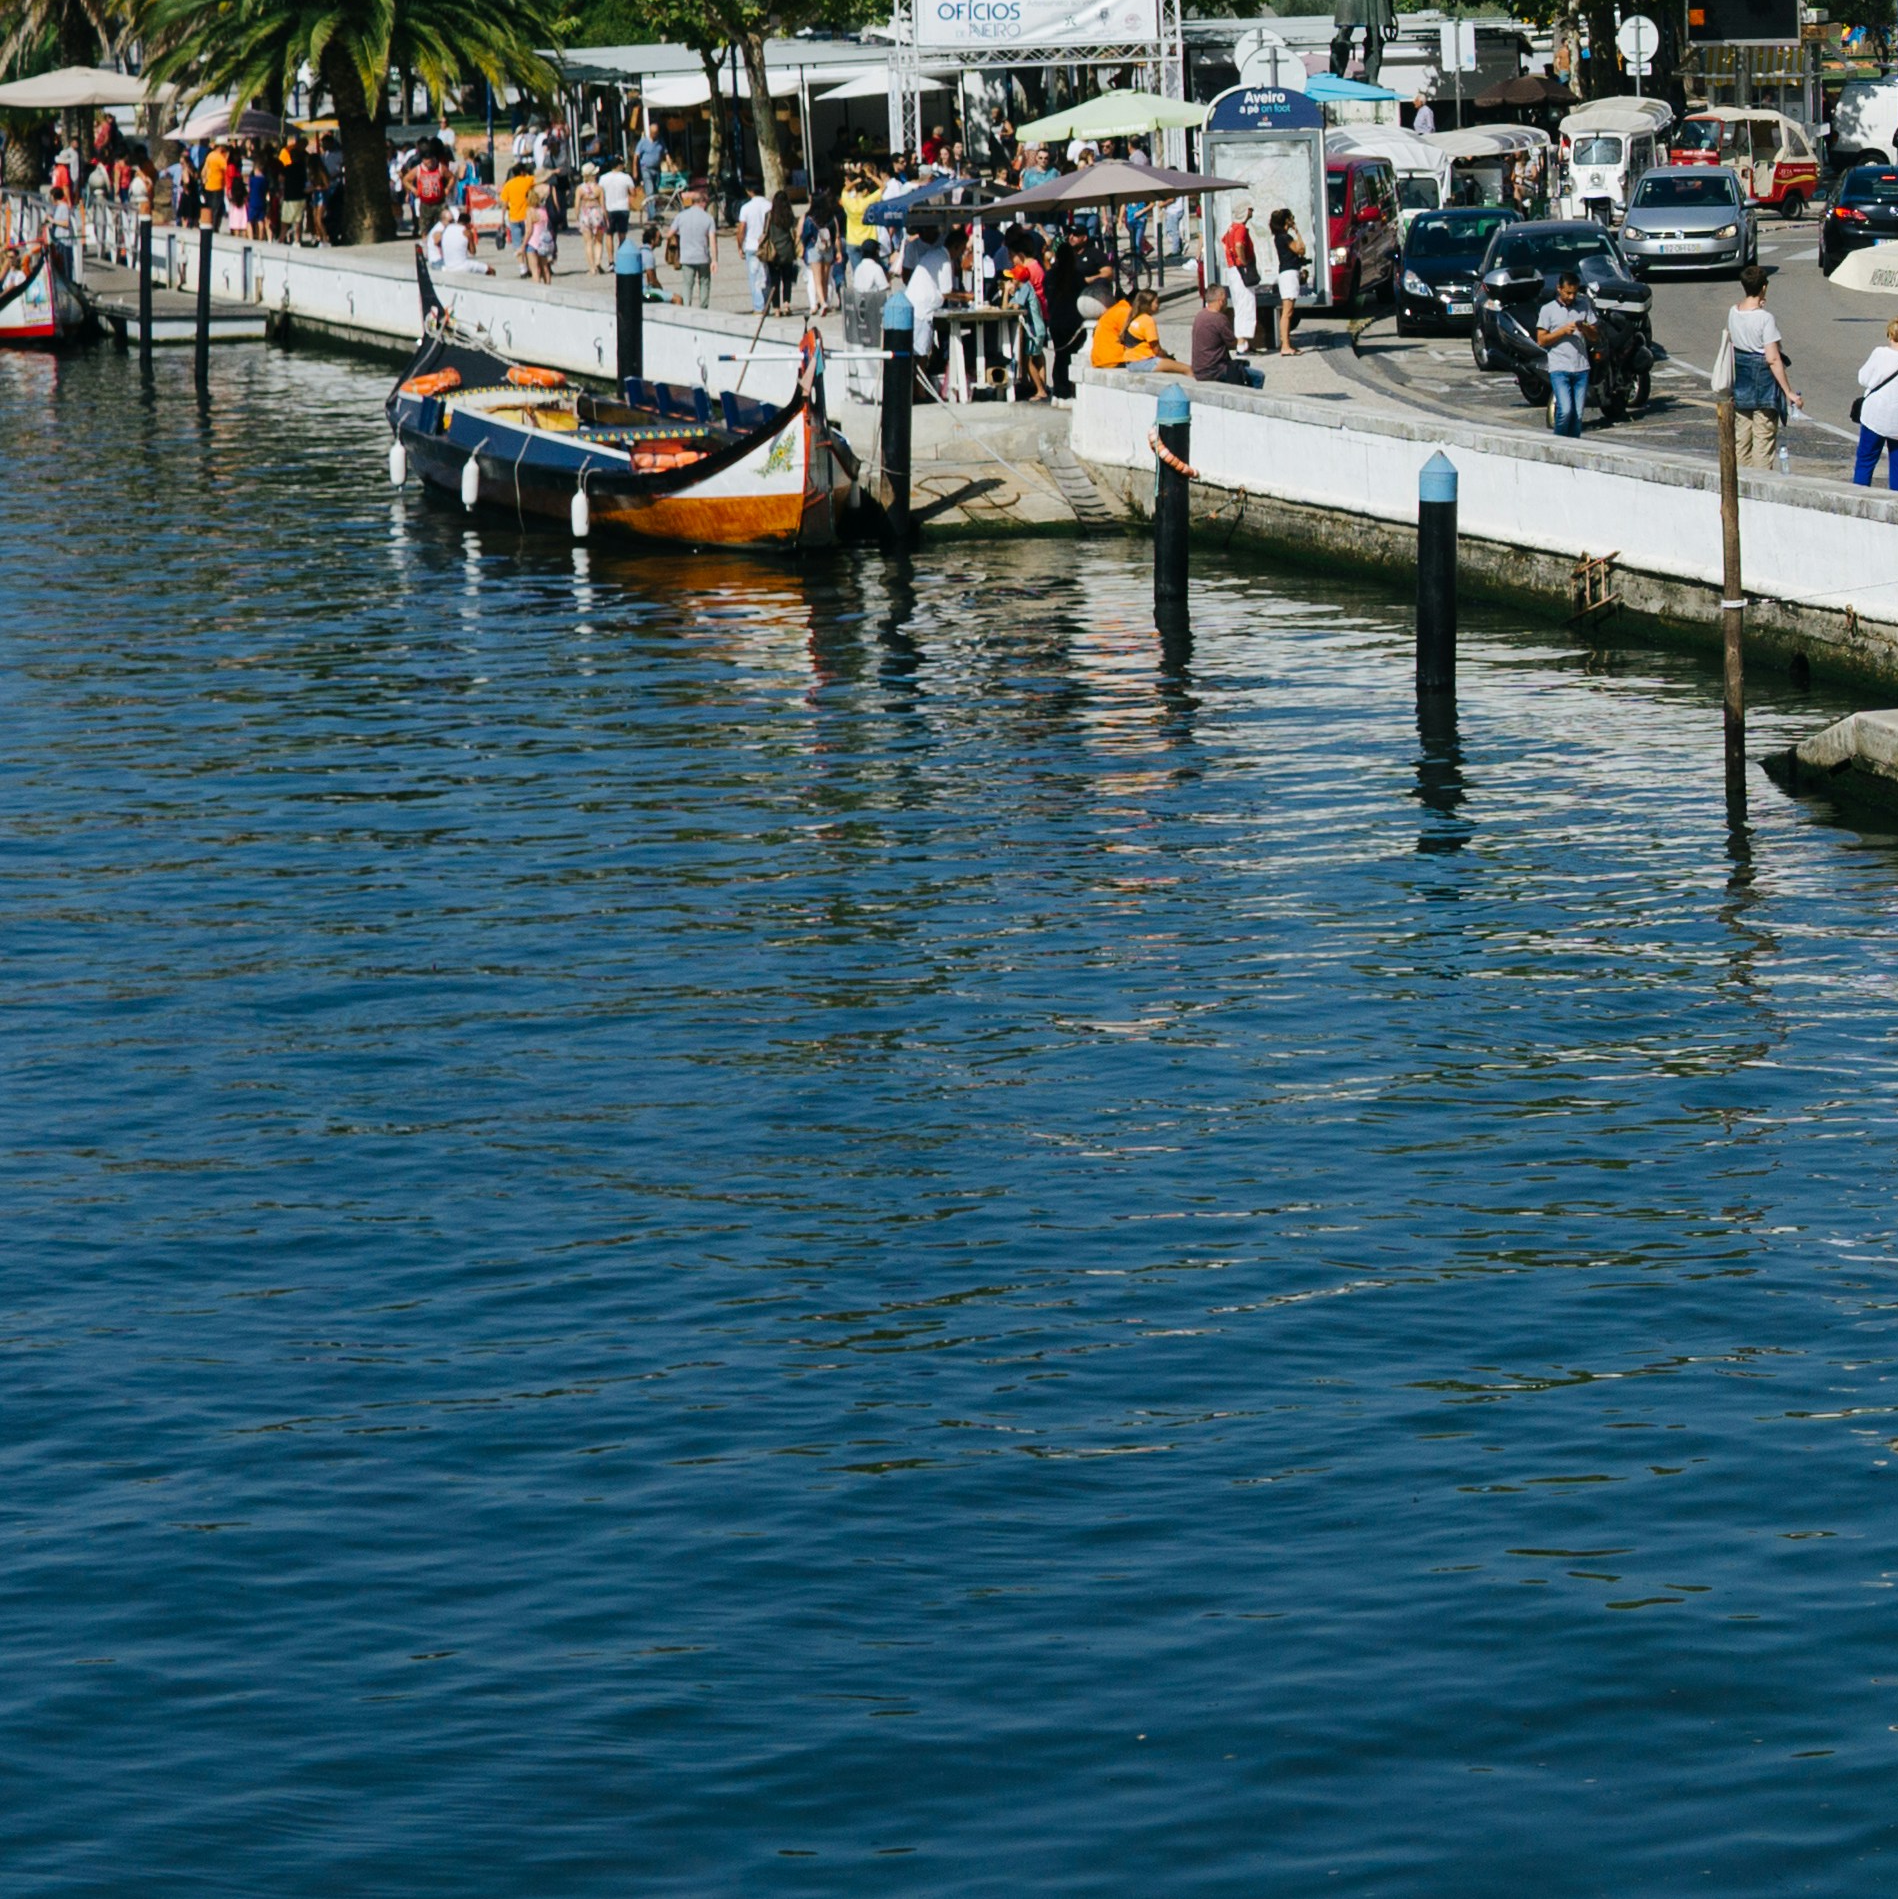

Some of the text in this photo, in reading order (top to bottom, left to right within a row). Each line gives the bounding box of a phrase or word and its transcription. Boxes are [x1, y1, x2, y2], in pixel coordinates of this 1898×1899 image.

[937, 0, 1021, 20] OFÍCIOS
[1244, 90, 1286, 104] Aveiro
[1261, 105, 1273, 114] on
[1274, 103, 1291, 113] foot
